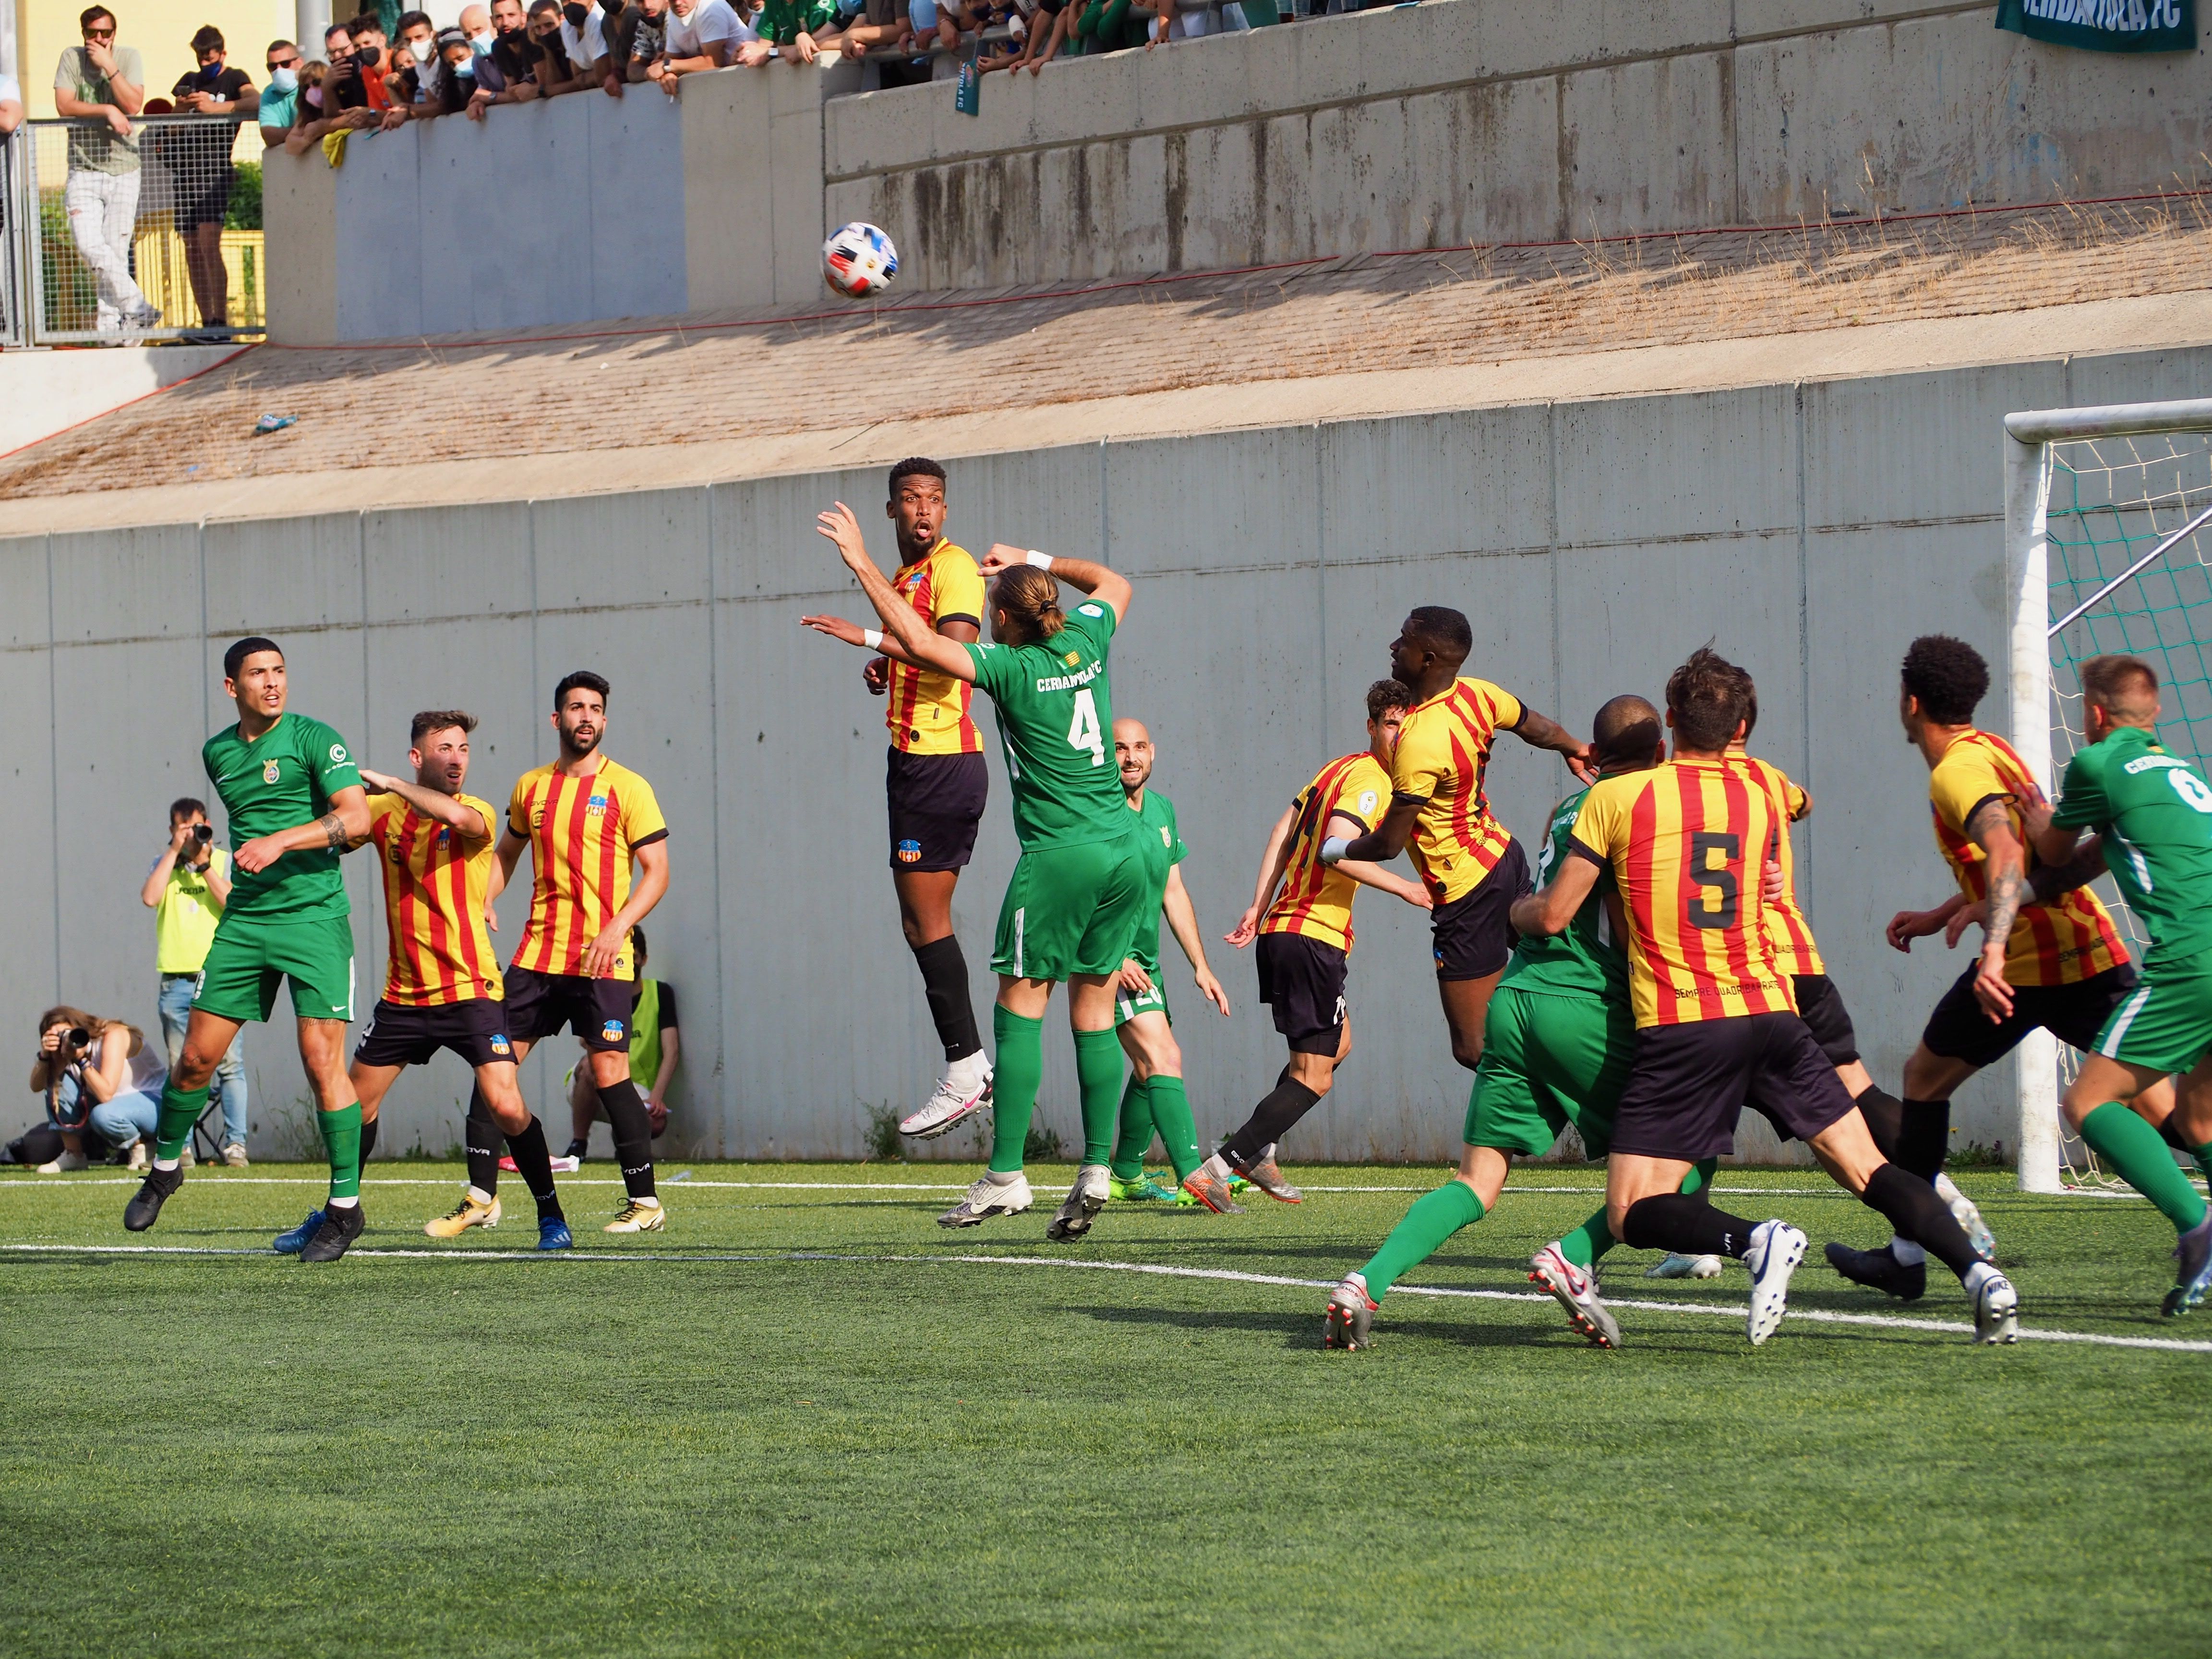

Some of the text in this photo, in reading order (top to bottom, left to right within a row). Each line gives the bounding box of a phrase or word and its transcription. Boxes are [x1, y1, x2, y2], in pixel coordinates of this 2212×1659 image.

[2023, 0, 2147, 31] DANYOLA
[1067, 688, 1105, 767] 4
[1688, 831, 1739, 929] 5
[1675, 981, 1780, 998] SEMPRE QUADRIBARRATS
[1987, 1280, 2009, 1298] NIKE
